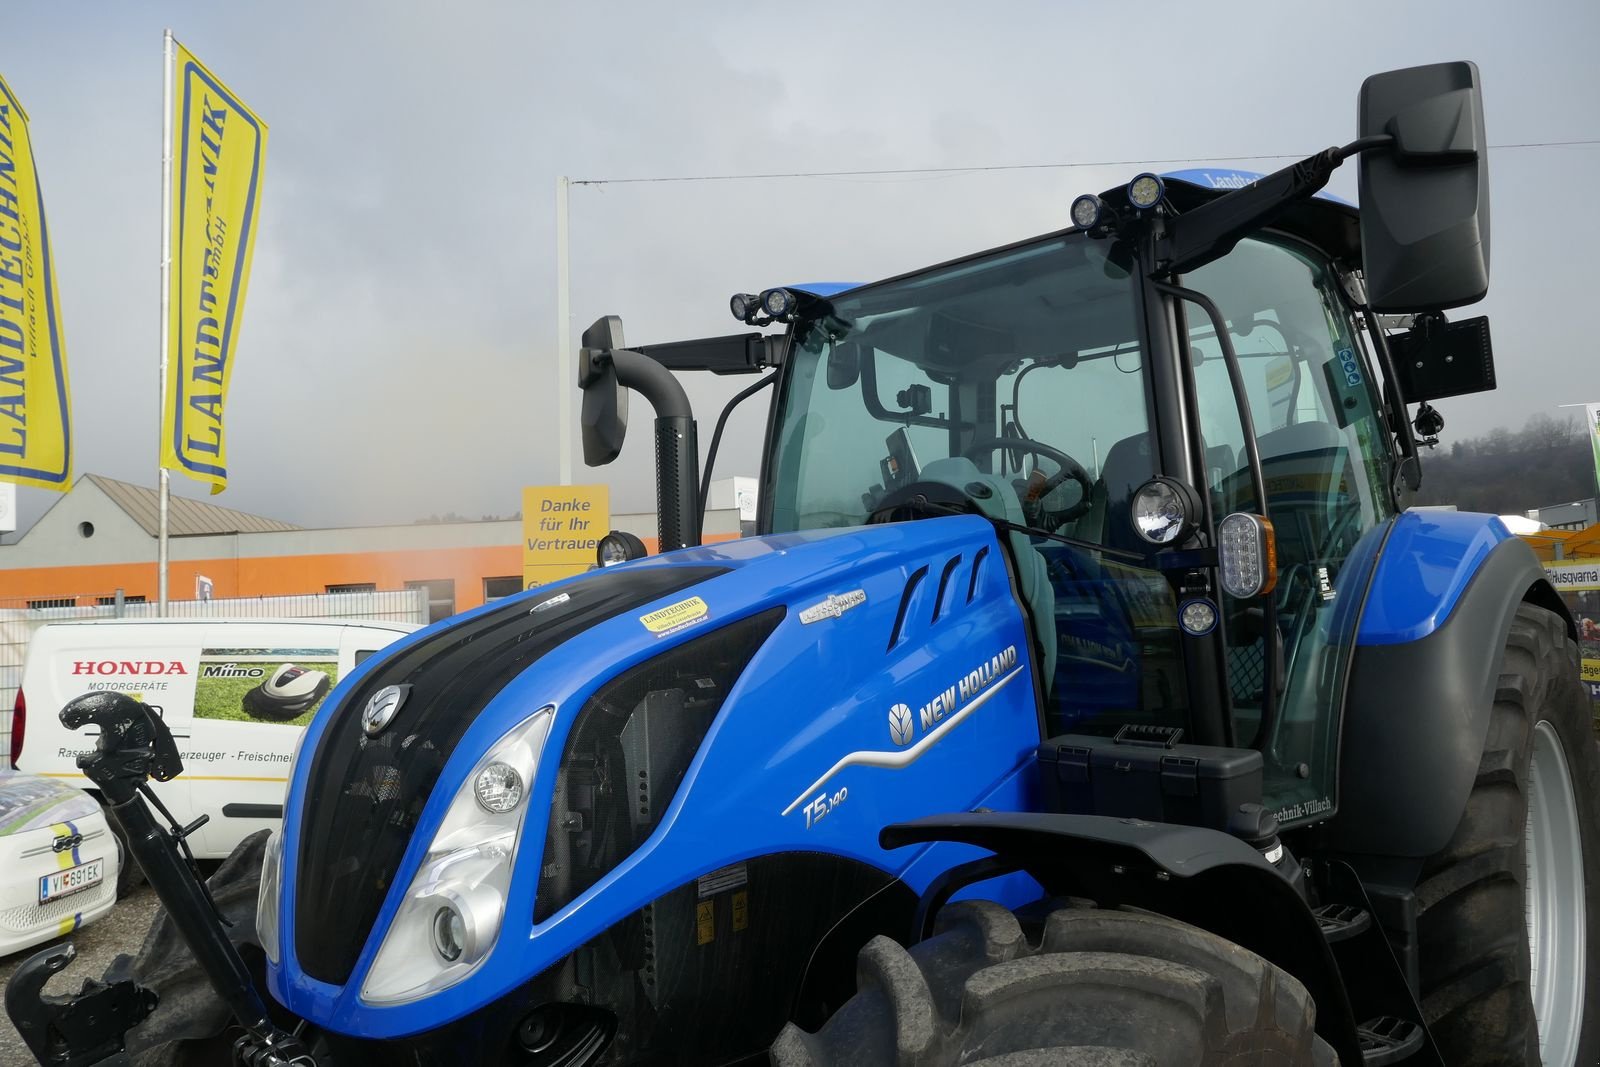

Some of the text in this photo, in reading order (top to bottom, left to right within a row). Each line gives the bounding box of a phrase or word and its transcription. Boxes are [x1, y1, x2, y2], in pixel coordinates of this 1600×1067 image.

[541, 499, 591, 512] Danke
[539, 518, 590, 531] für Ihr
[1552, 570, 1598, 585] Husqvarna
[643, 598, 700, 624] LANDTECHNIK
[71, 661, 188, 675] HONDA
[88, 680, 169, 691] MOTORGERÄTE
[919, 685, 956, 732] NEW
[958, 644, 1017, 704] HOLLAND
[179, 751, 227, 762] erzeuger
[237, 750, 293, 764] Freischnei
[803, 787, 848, 830] T5.140
[1273, 796, 1331, 822] echnik-Villach
[70, 864, 99, 886] 691EK
